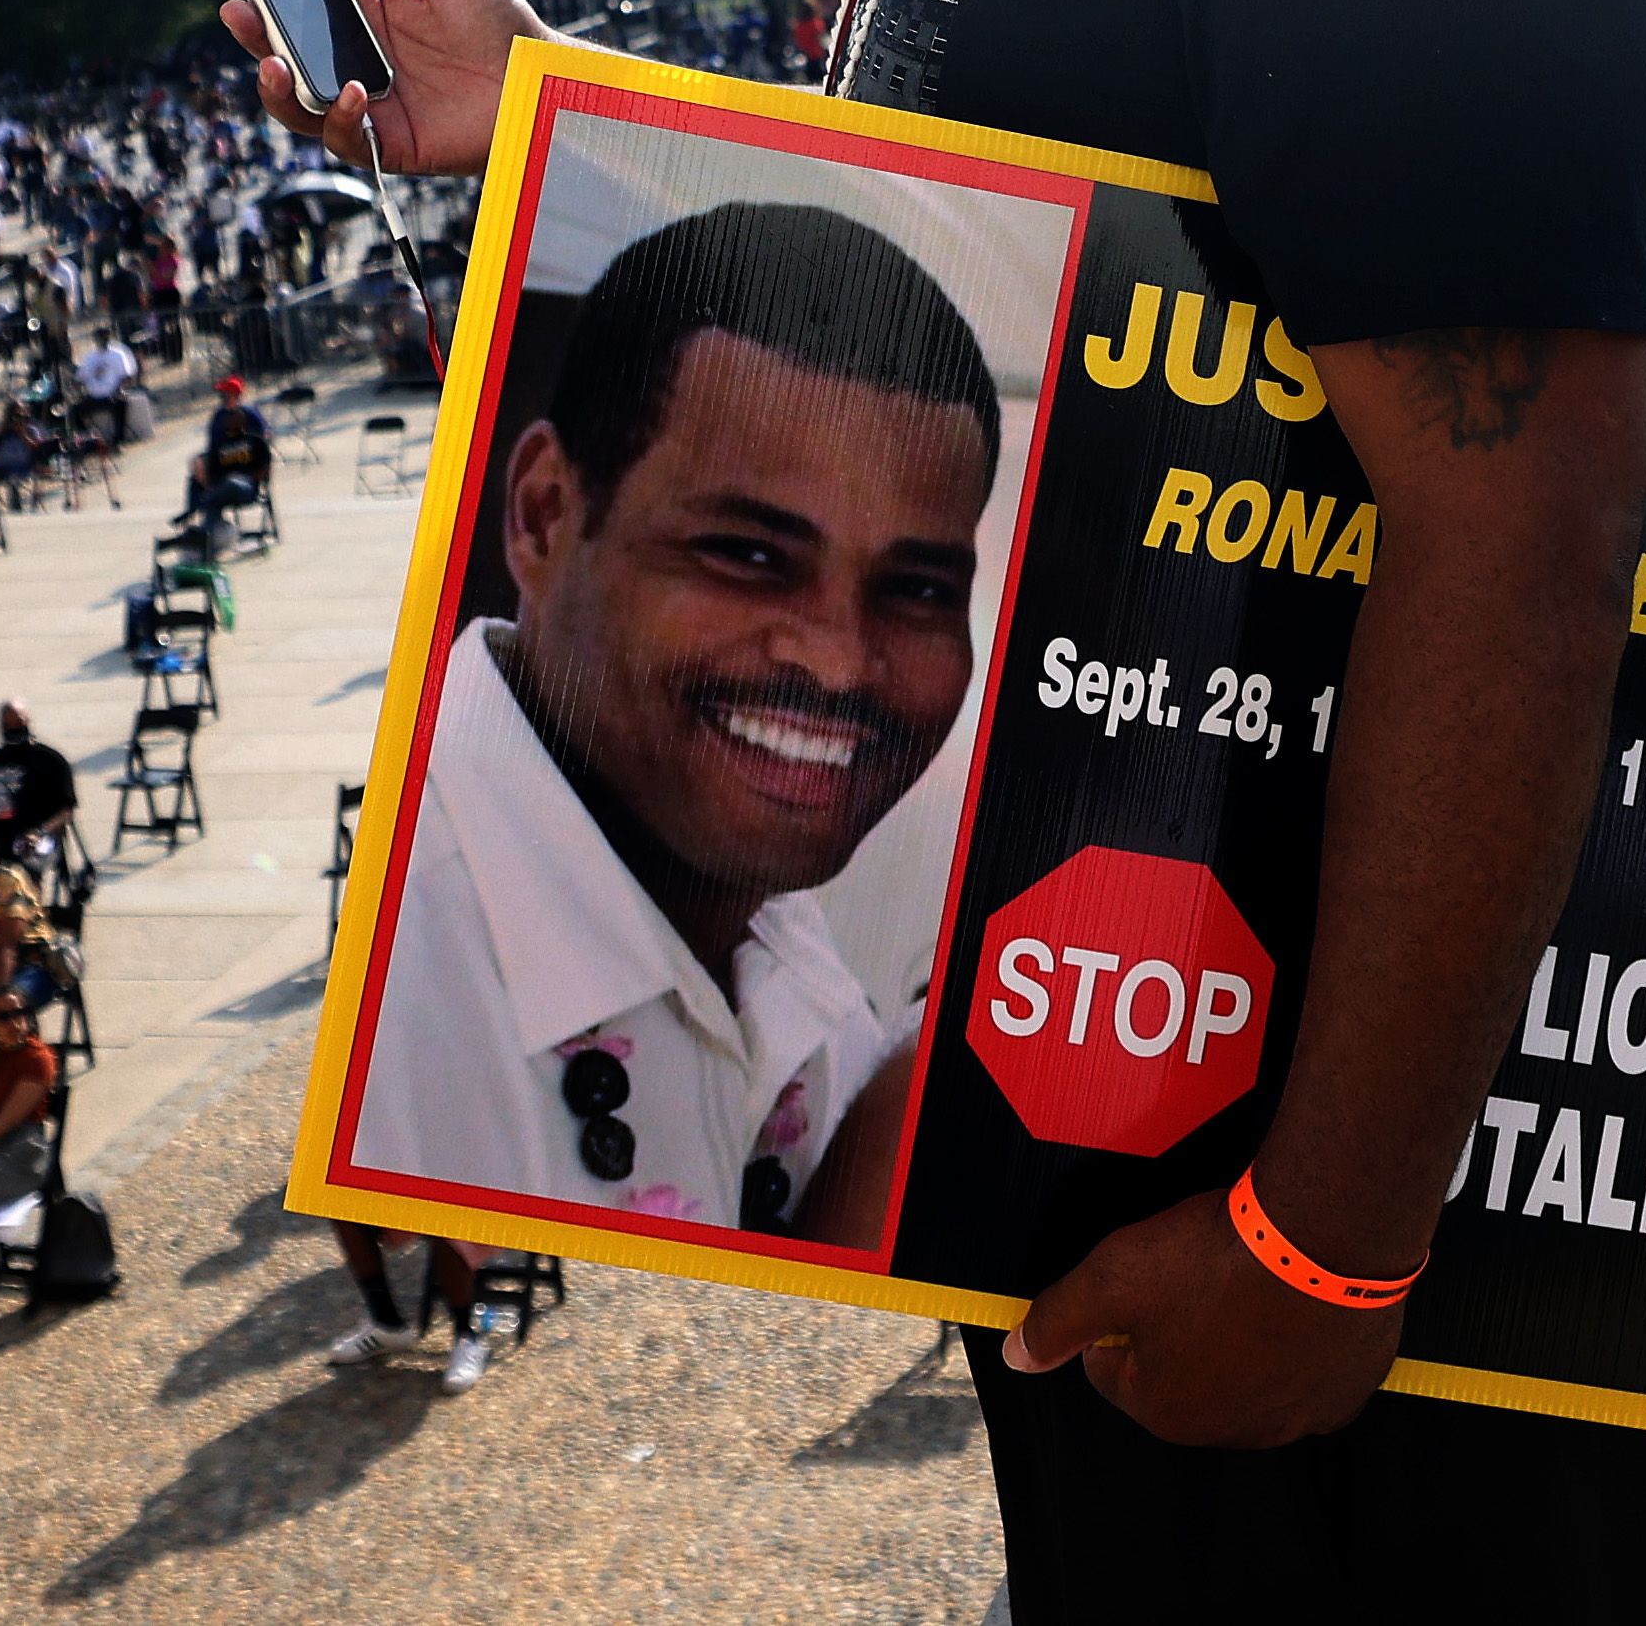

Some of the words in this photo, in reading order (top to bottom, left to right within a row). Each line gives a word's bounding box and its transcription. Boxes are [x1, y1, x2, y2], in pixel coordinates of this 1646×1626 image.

[1144, 468, 1377, 584] RONA
[1039, 638, 1180, 737] Sept.
[1199, 667, 1282, 759] 28,
[991, 938, 1250, 1064] STOP
